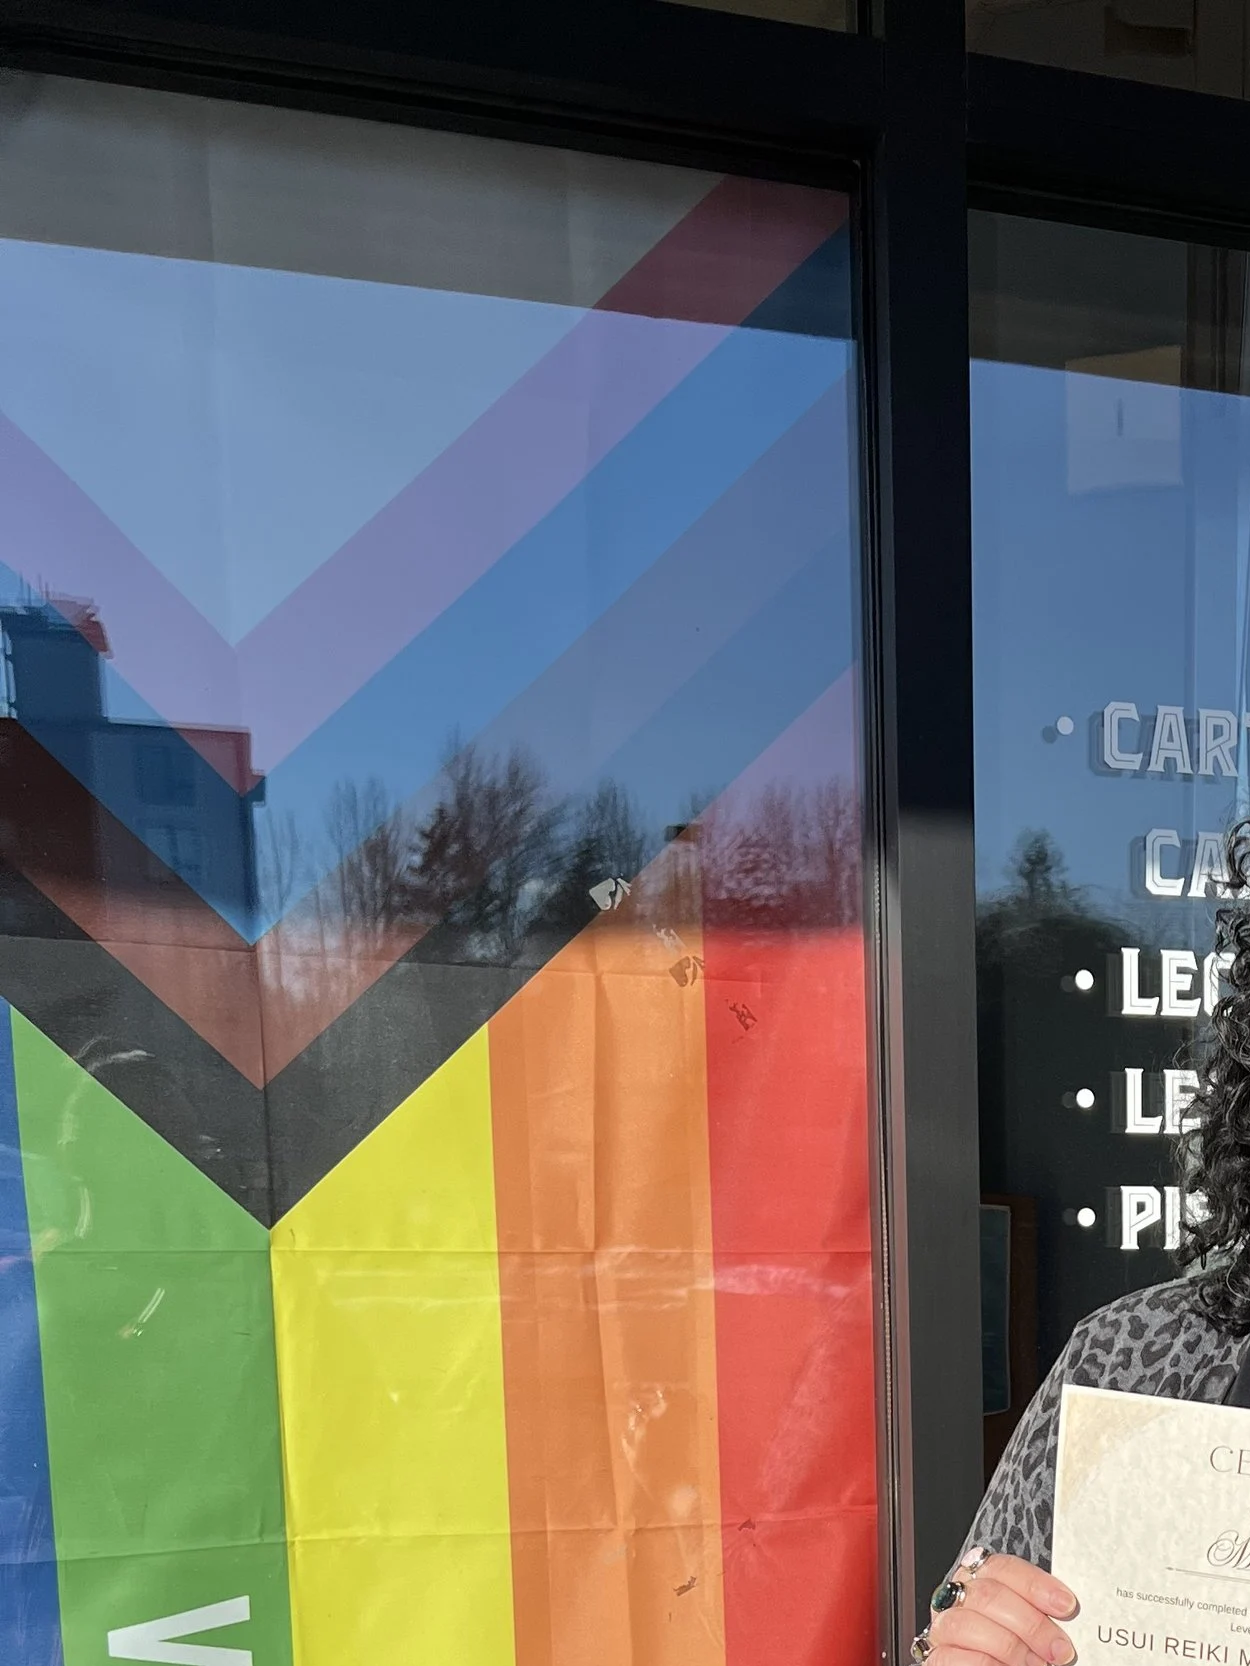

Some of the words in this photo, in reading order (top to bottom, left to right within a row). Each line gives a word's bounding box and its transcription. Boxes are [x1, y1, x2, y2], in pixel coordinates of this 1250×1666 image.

[1115, 1587, 1134, 1600] has
[1135, 1592, 1195, 1610] successfully
[1196, 1600, 1248, 1617] completed
[1097, 1625, 1154, 1652] USUI
[1164, 1637, 1229, 1664] REIKI
